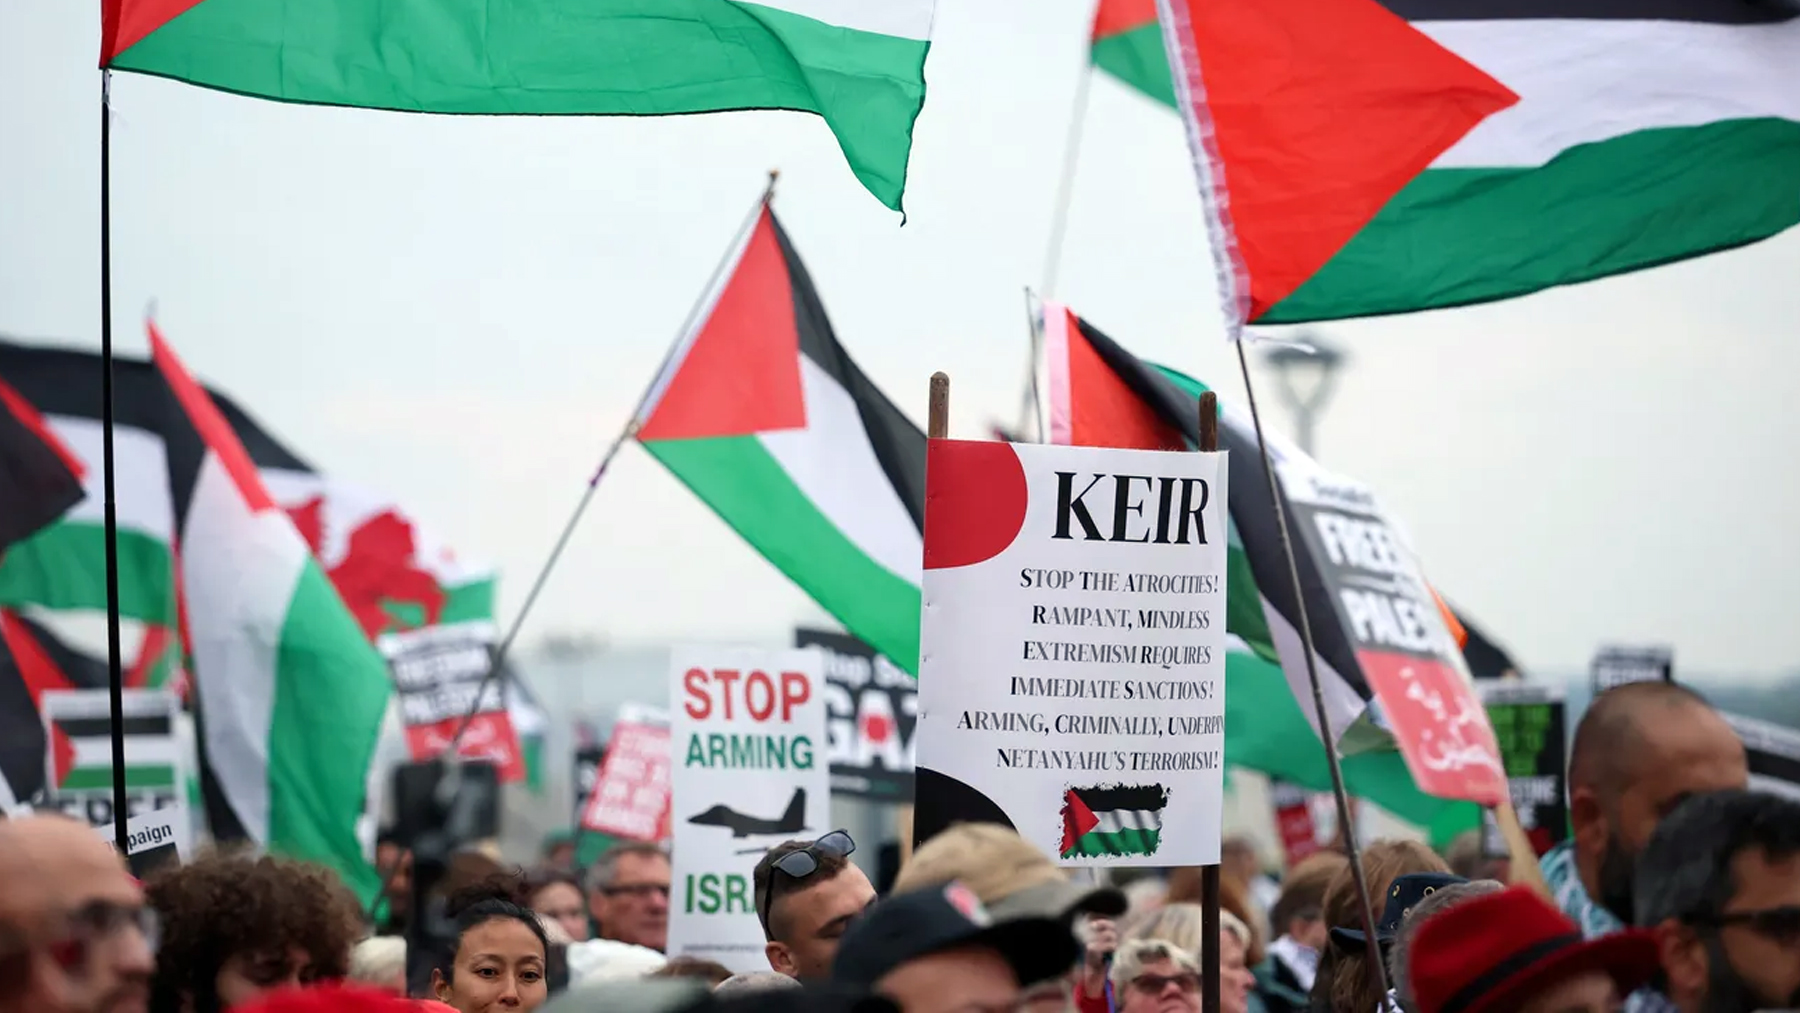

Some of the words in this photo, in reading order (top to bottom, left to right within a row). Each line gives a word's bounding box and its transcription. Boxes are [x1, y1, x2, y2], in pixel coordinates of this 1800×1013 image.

[1051, 471, 1209, 545] KEIR
[1020, 568, 1074, 589] STOP
[1080, 571, 1119, 591] THE
[1123, 573, 1219, 594] ATROCITIES!
[1032, 605, 1132, 631] RAMPANT,
[1137, 609, 1210, 629] MINDLESS
[1023, 641, 1137, 664] EXTREMISM
[1141, 645, 1211, 669] REQUIRES
[684, 667, 811, 722] STOP
[1010, 676, 1120, 698] IMMEDIATE
[1123, 680, 1214, 700] SANCTIONS!
[957, 710, 1049, 735] ARMING,
[1055, 713, 1163, 737] CRIMINALLY,
[686, 734, 814, 770] ARMING
[997, 748, 1126, 771] NETANYAHU'S
[1130, 750, 1218, 771] TERRORISM!
[113, 824, 172, 852] paign
[685, 873, 755, 915] ISR
